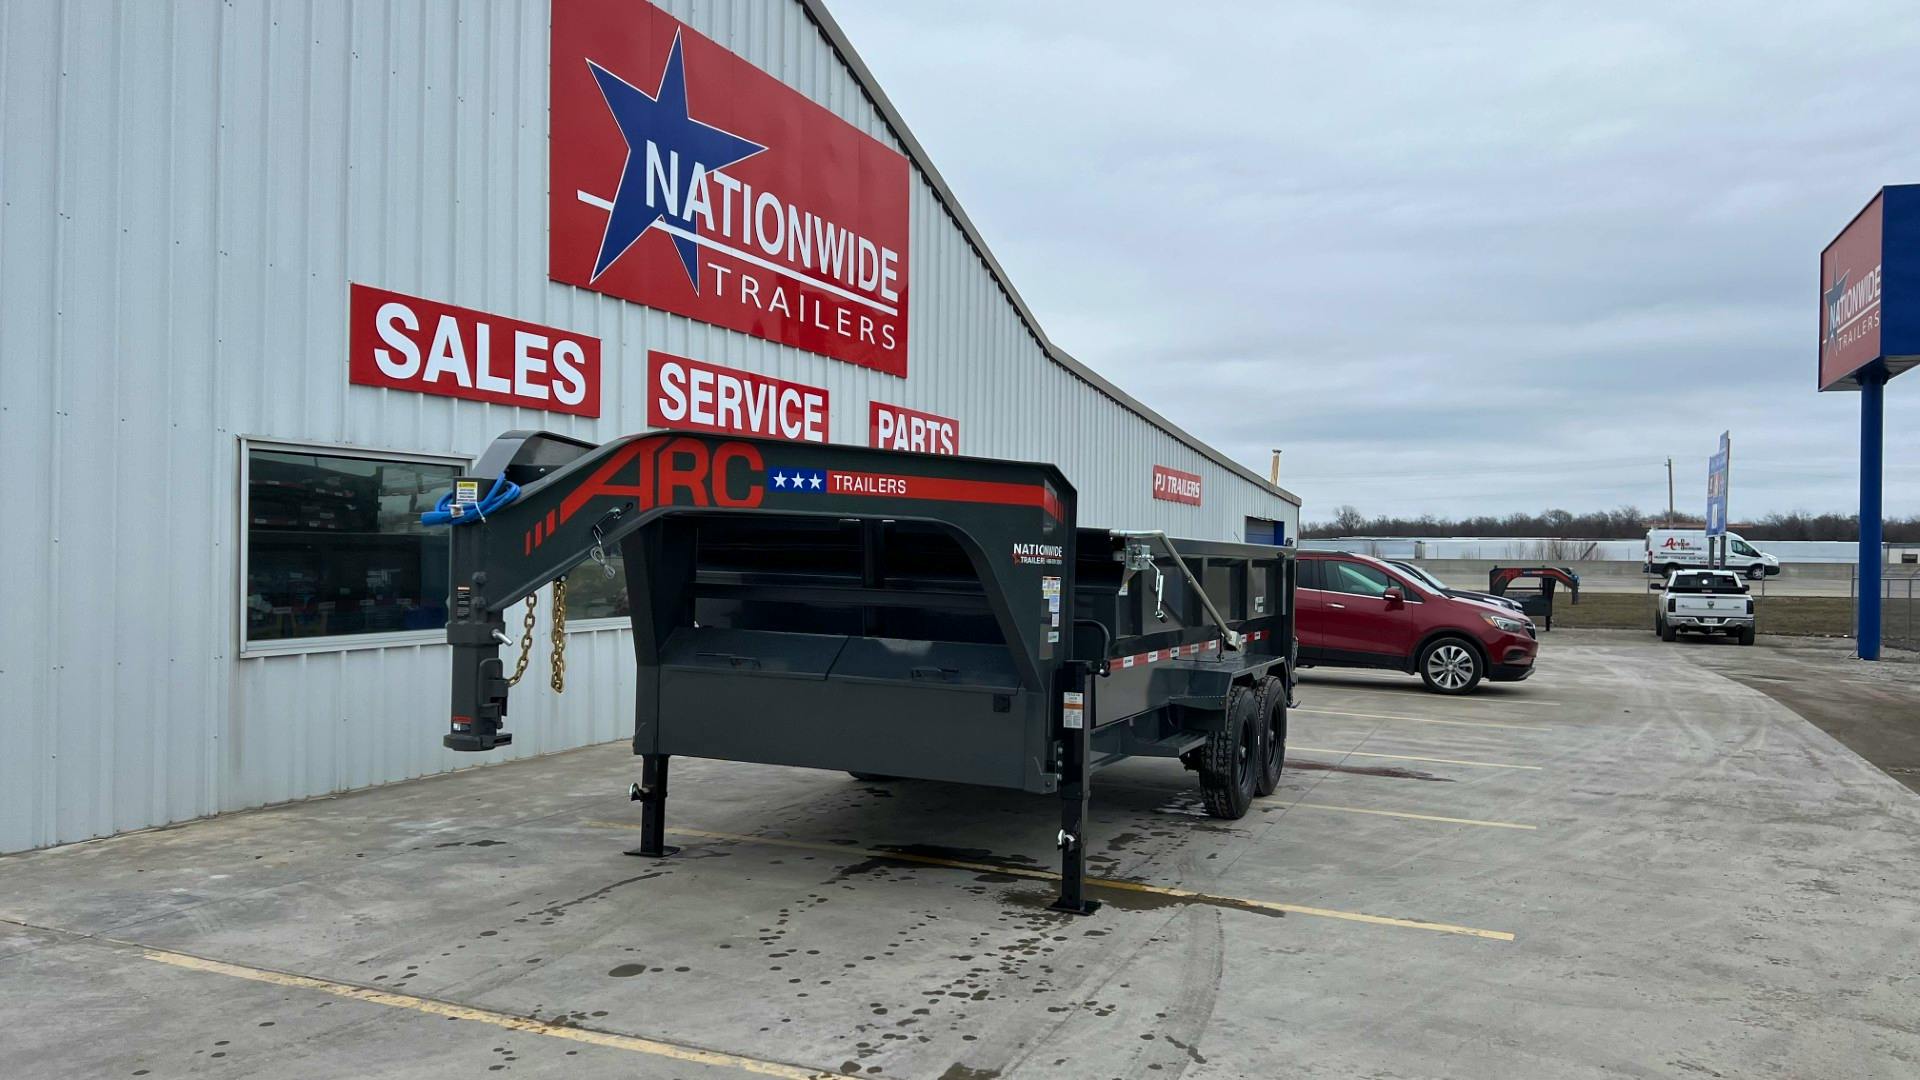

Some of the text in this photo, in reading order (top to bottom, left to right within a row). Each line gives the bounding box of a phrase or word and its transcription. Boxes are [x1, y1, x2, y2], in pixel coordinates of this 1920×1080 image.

[646, 139, 898, 303] NATIONWIDE
[707, 262, 896, 350] TRAILERS
[1829, 264, 1881, 331] NATIONWIDE
[1839, 310, 1880, 351] TRAILERS
[374, 302, 586, 405] SALES
[658, 362, 823, 442] SERVICE
[879, 409, 953, 455] PARTS
[560, 436, 765, 525] ARC
[833, 474, 907, 494] TRAILERS
[1155, 473, 1200, 498] PJ TRAILERS
